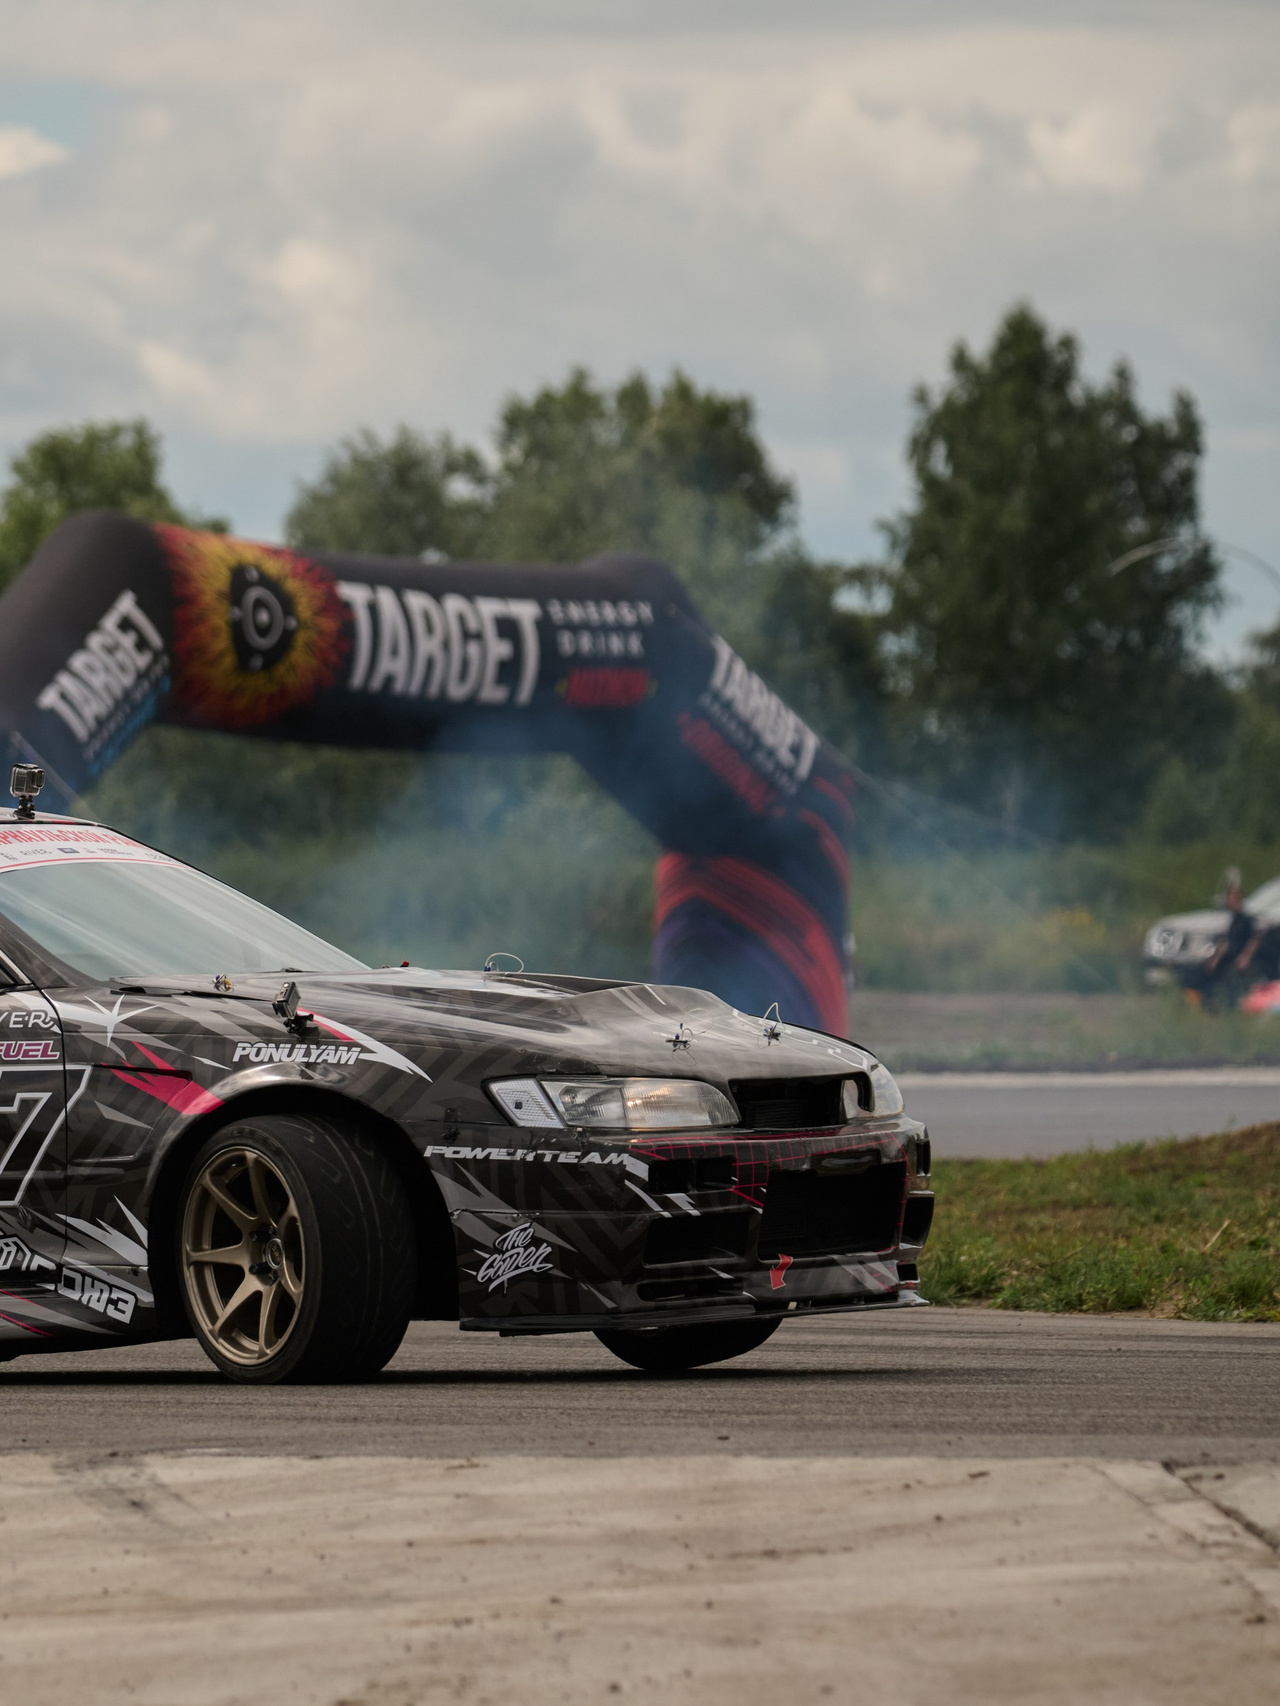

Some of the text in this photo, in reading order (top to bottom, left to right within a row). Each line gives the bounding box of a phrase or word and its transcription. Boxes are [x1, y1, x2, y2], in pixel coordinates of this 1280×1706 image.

[36, 588, 164, 744] TARGET
[336, 580, 542, 706] TARGET
[557, 629, 644, 658] DRINK
[710, 633, 820, 781] TARGET
[232, 1043, 362, 1066] PONULYAM
